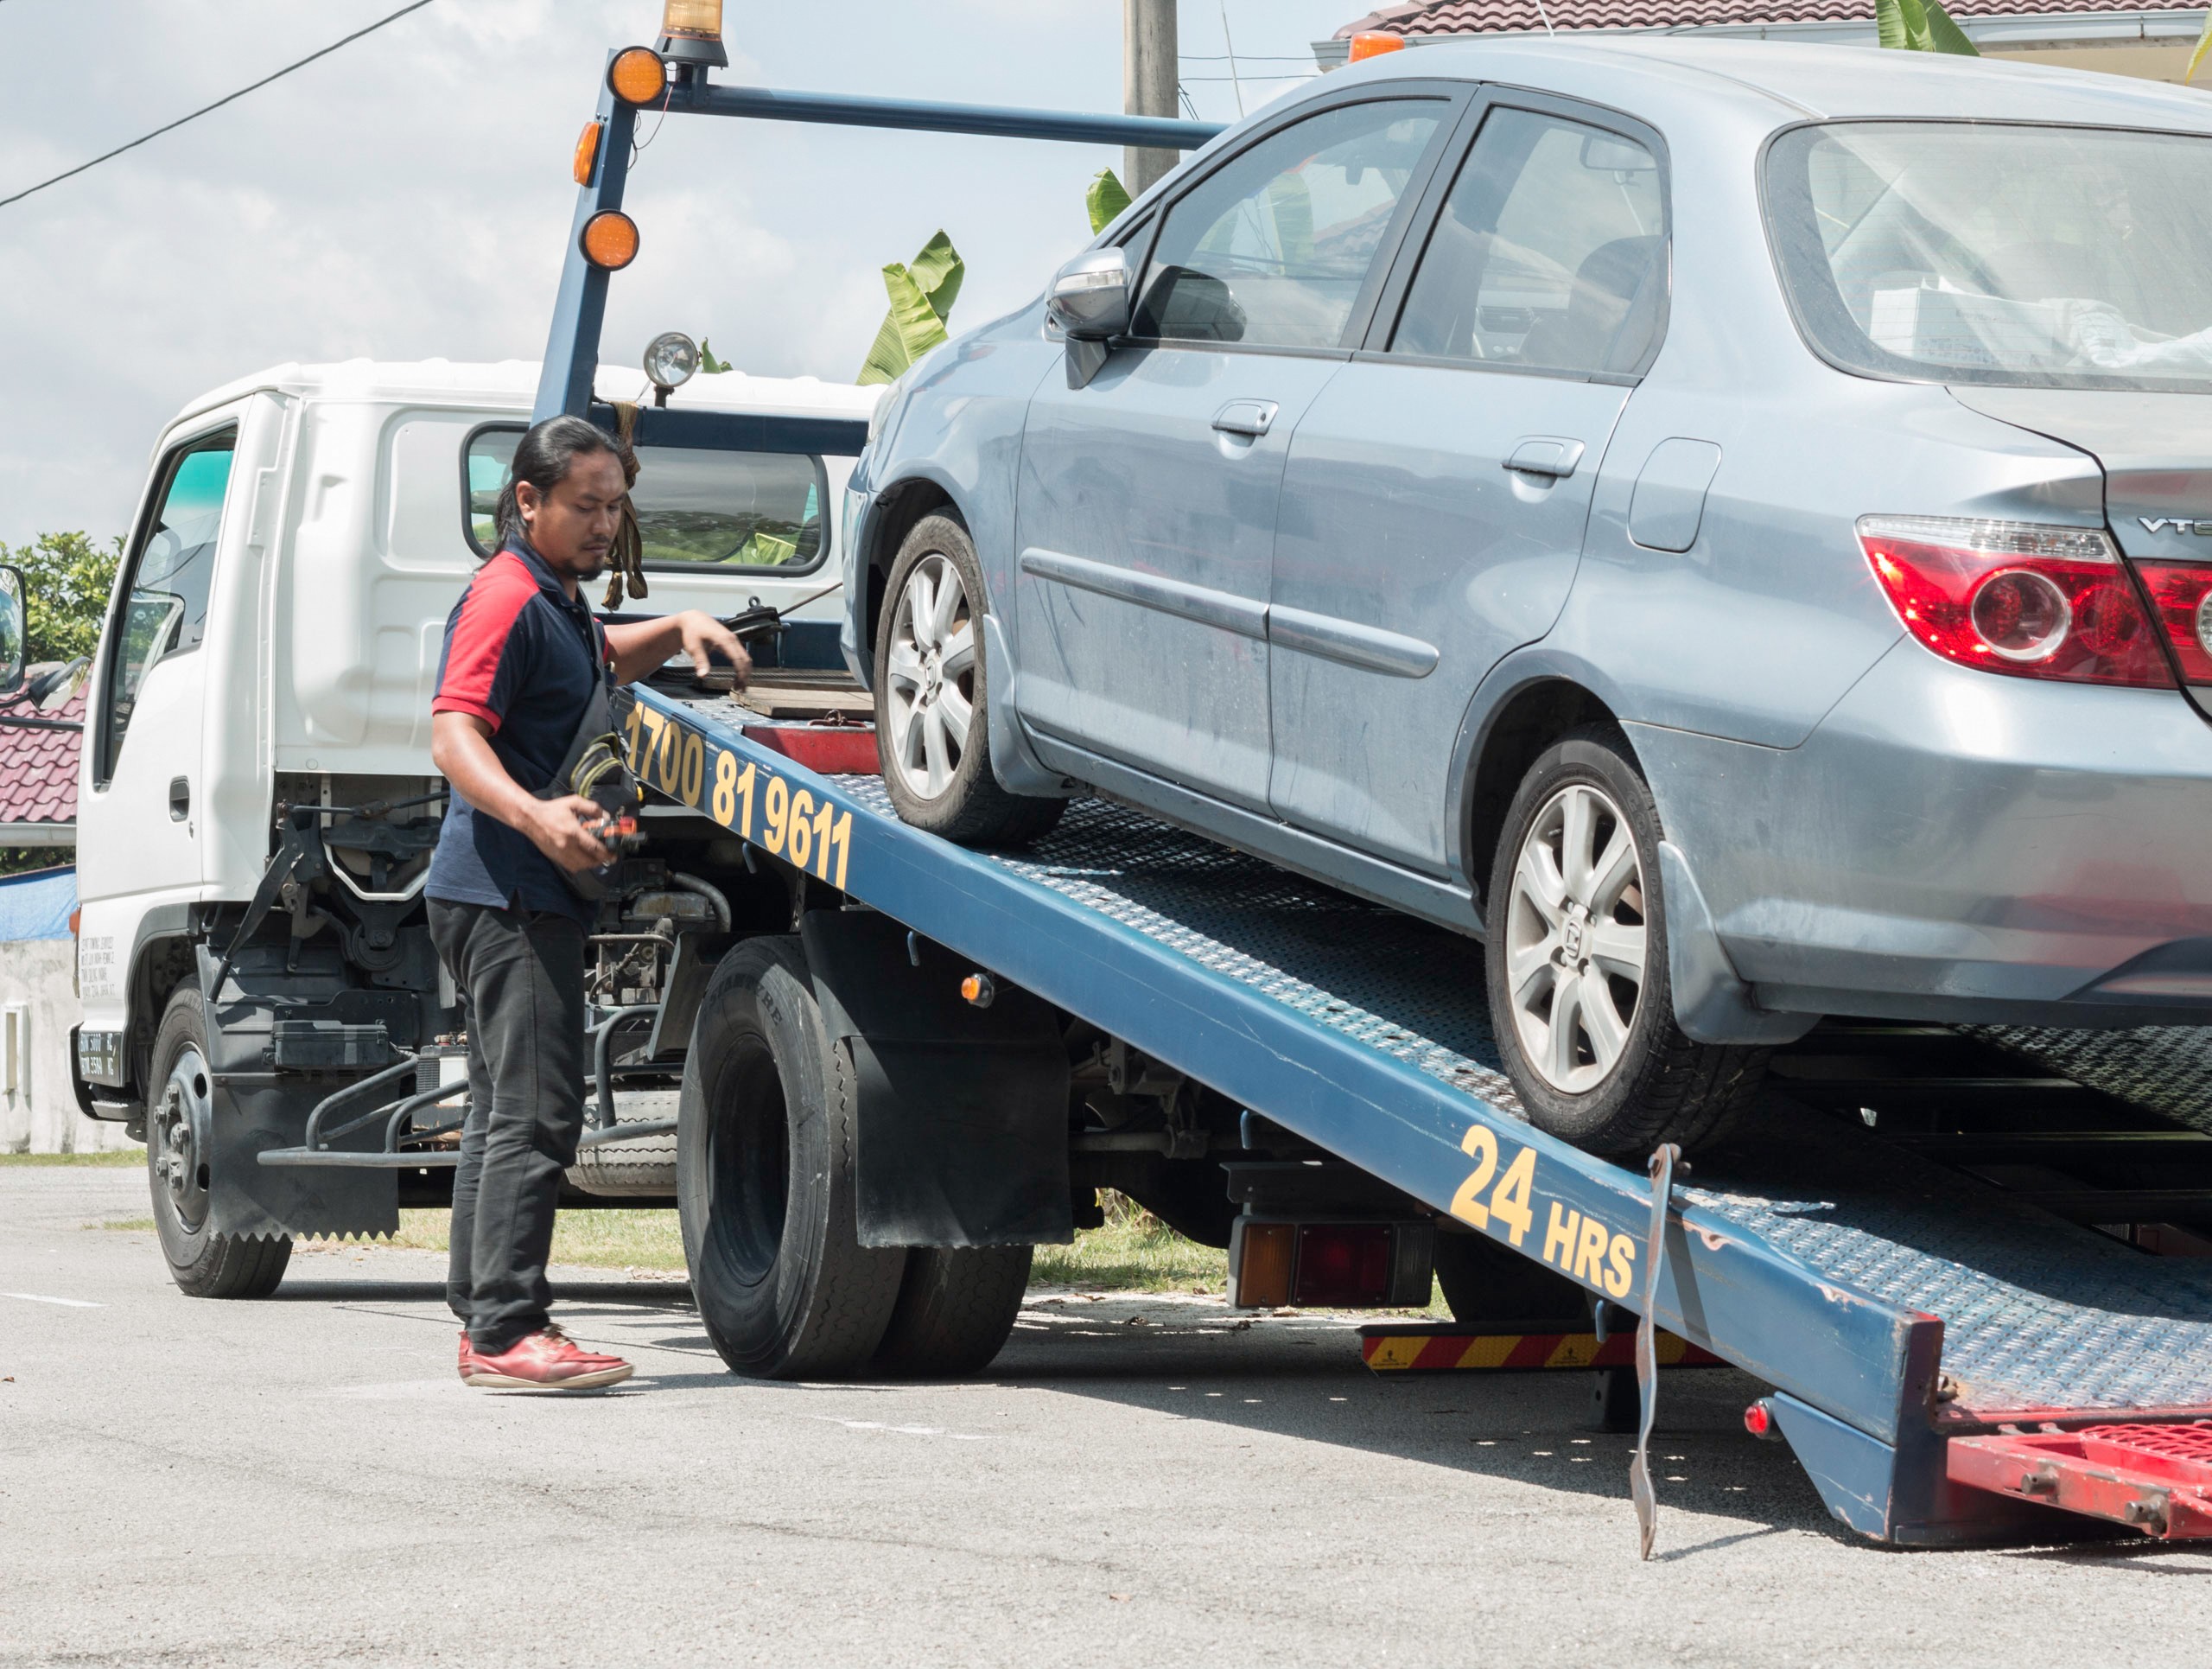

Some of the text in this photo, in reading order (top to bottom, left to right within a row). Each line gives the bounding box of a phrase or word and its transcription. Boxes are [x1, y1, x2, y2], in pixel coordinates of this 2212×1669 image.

[626, 701, 853, 891] 1700 81 9611
[1450, 1124, 1636, 1298] 24 HRS
